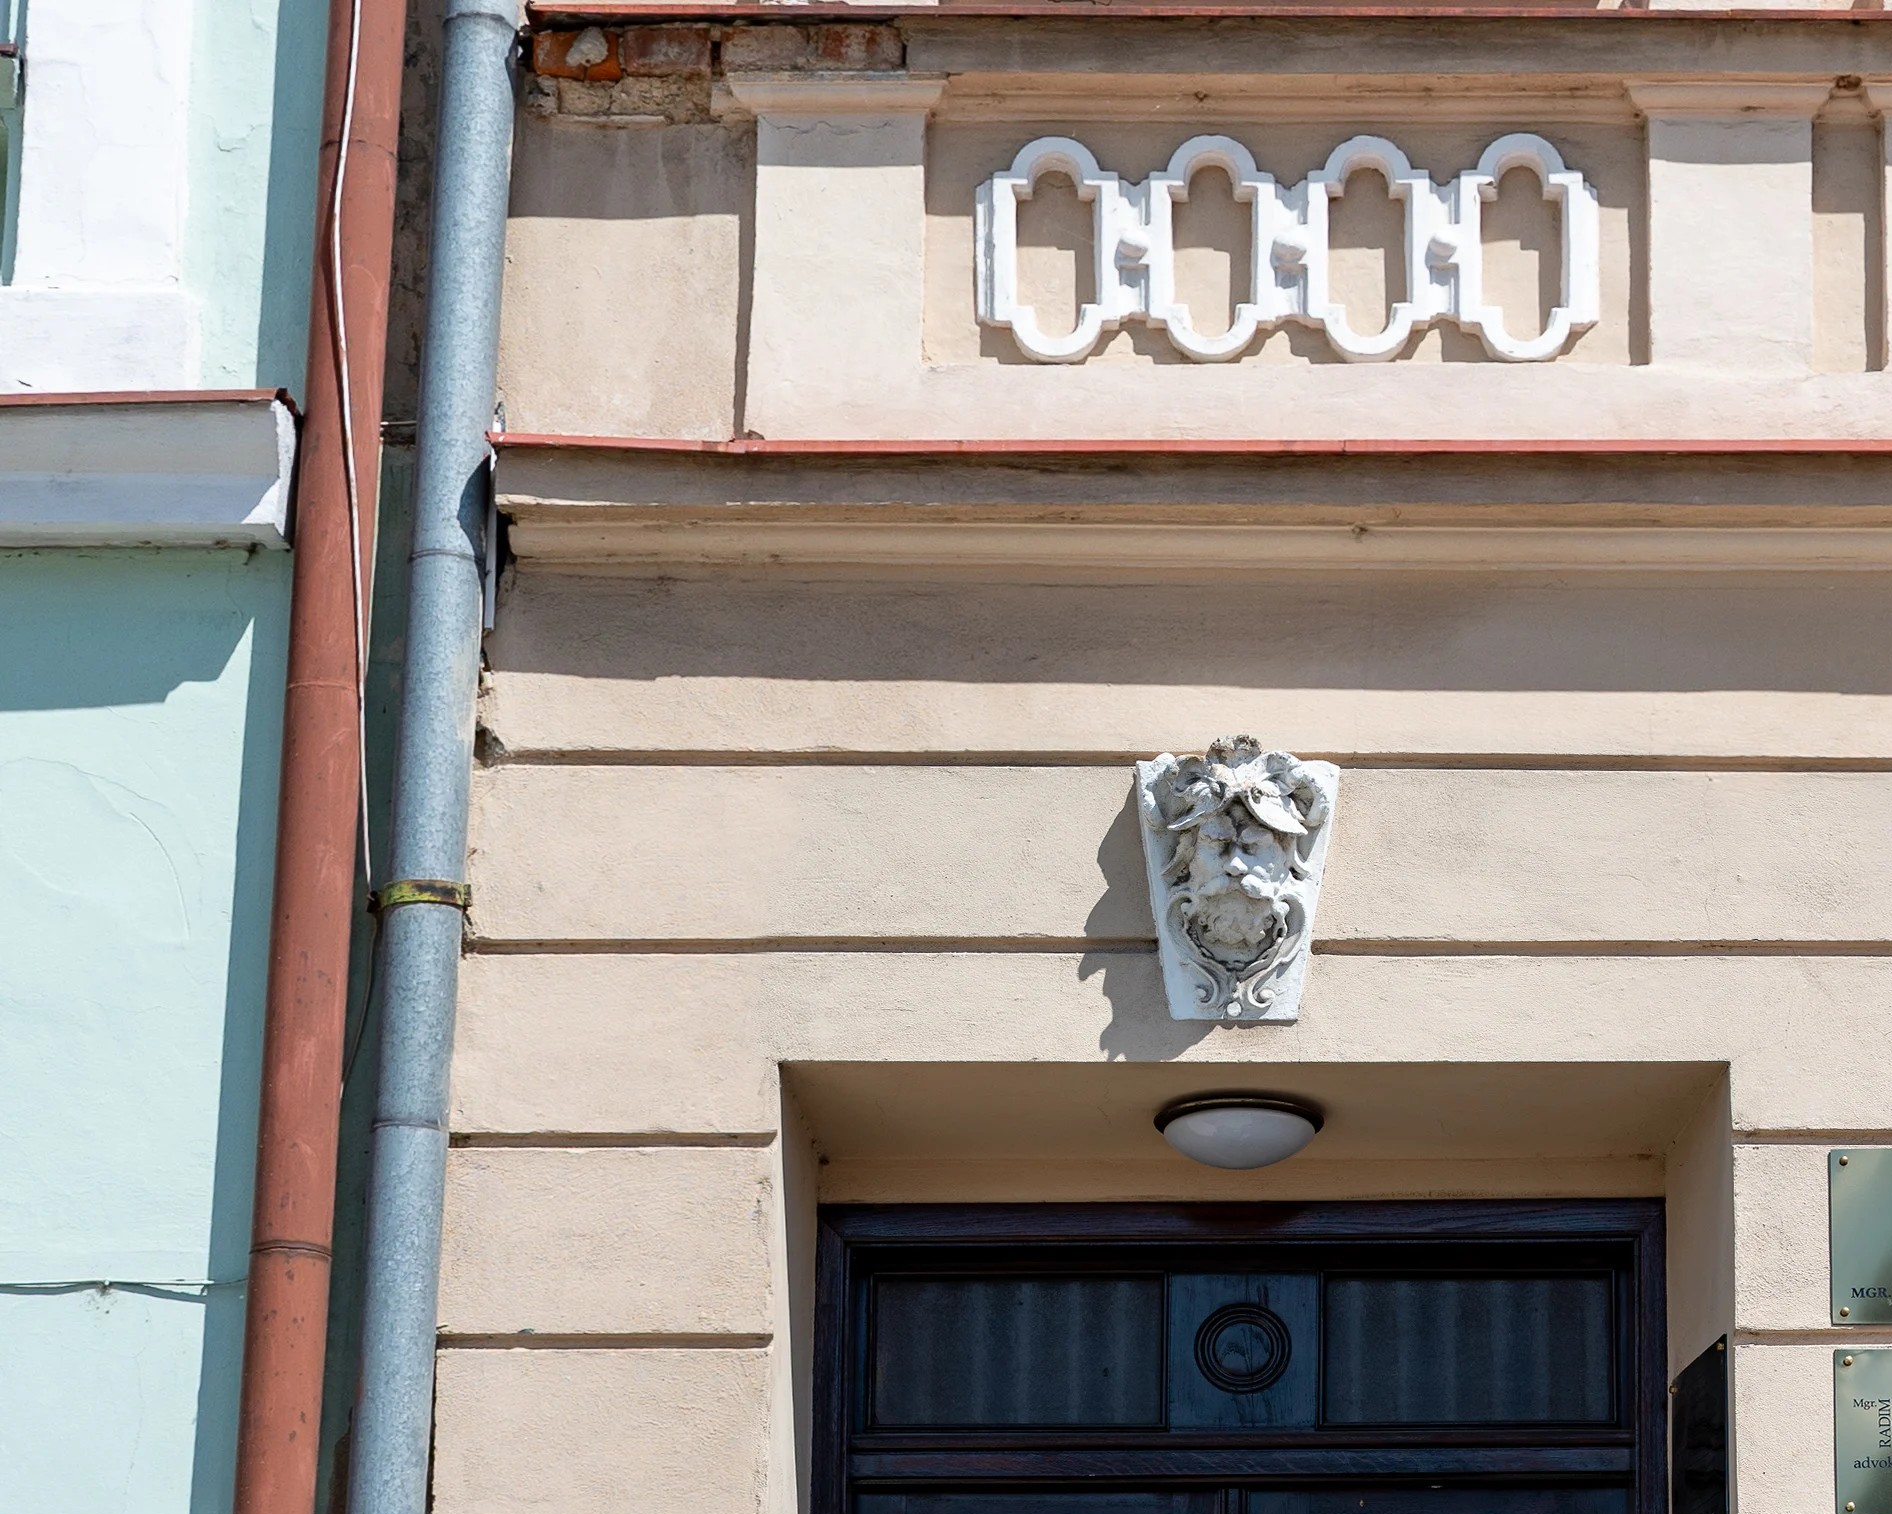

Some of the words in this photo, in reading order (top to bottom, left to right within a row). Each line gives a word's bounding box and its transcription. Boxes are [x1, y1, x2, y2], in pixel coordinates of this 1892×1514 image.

[1851, 1286, 1892, 1299] MGR.
[1852, 1398, 1877, 1410] Mgr.
[1878, 1398, 1891, 1448] RADIM
